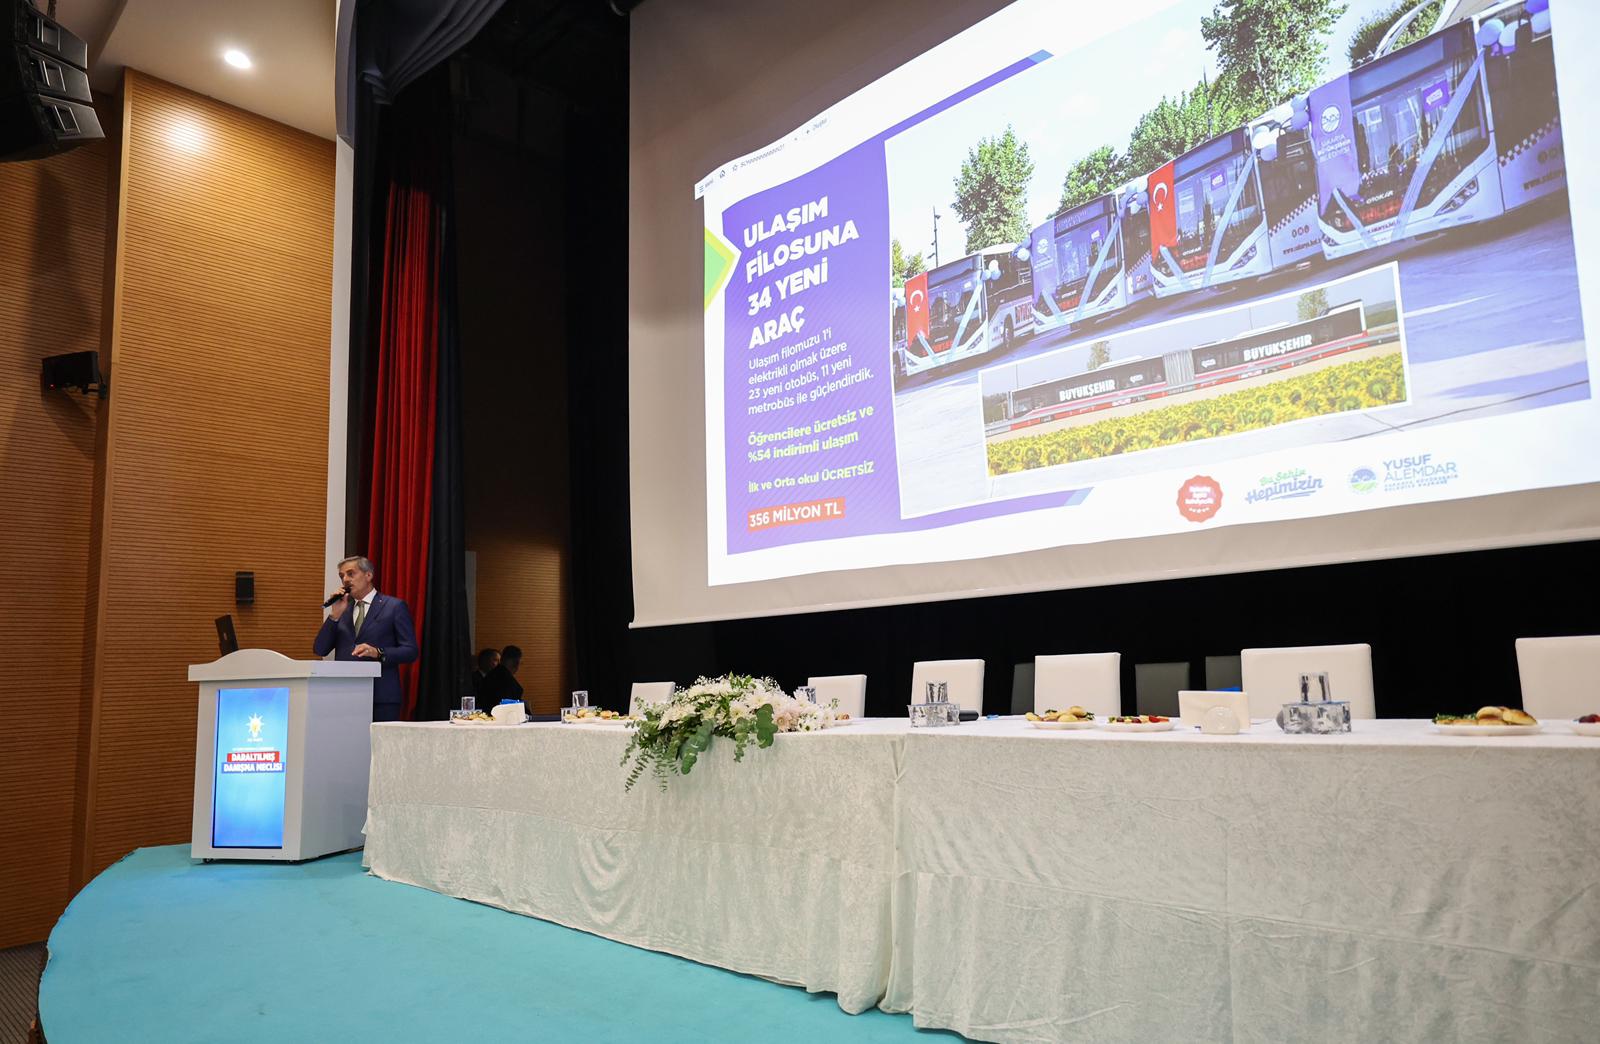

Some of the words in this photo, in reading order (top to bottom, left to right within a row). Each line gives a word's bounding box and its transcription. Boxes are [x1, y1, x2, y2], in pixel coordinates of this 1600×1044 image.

[743, 196, 829, 248] ULAŞIM
[745, 219, 860, 284] FİLOSUNA
[748, 286, 773, 316] 34
[775, 256, 829, 300] YENİ
[748, 305, 806, 349] ARAÇ
[748, 353, 780, 370] Ulaşım
[781, 333, 821, 360] filomuzu
[748, 364, 789, 386] elektrikli
[790, 351, 819, 373] olmak
[819, 340, 848, 358] üzere
[748, 387, 761, 400] 23
[762, 381, 783, 399] yeni
[784, 371, 820, 392] otobüs,
[821, 366, 830, 377] 11
[831, 355, 853, 374] yeni
[748, 395, 795, 415] metrobüs
[796, 390, 809, 405] ile
[810, 368, 875, 402] güçlendirdik.
[748, 425, 813, 447] Öğrencilere
[813, 411, 858, 433] ücretsiz
[858, 405, 874, 417] ve
[748, 449, 771, 463] %54
[773, 439, 820, 459] indirimli
[821, 431, 859, 451] ulaşım
[761, 481, 773, 490] ve
[774, 475, 797, 490] Orta
[797, 471, 820, 485] okul
[821, 460, 875, 481] ÜCRETSİZ
[1382, 453, 1432, 471] YUSUF
[1383, 462, 1457, 482] ALEMDAR
[1244, 475, 1324, 504] Hepimizin
[749, 512, 770, 528] 356
[772, 504, 822, 523] MİLYON
[824, 502, 843, 516] TL
